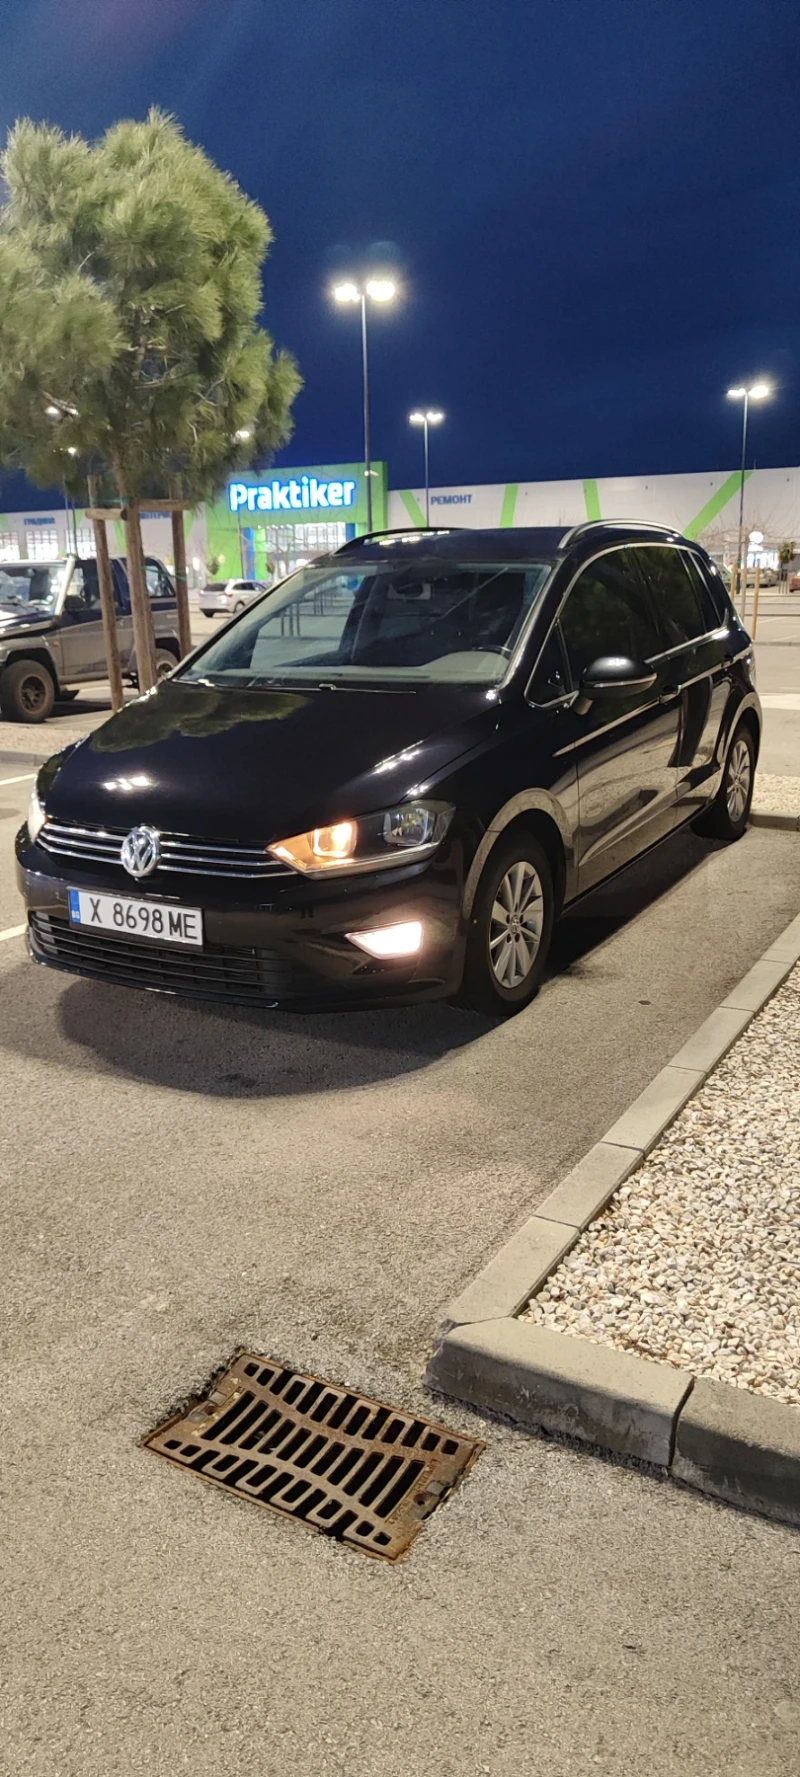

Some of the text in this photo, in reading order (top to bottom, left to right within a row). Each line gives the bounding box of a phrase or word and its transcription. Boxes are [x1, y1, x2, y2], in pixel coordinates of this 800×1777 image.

[229, 475, 356, 512] Praktiker
[430, 494, 472, 505] РЕМОНТ
[112, 902, 164, 934] 8698
[168, 910, 198, 940] ME
